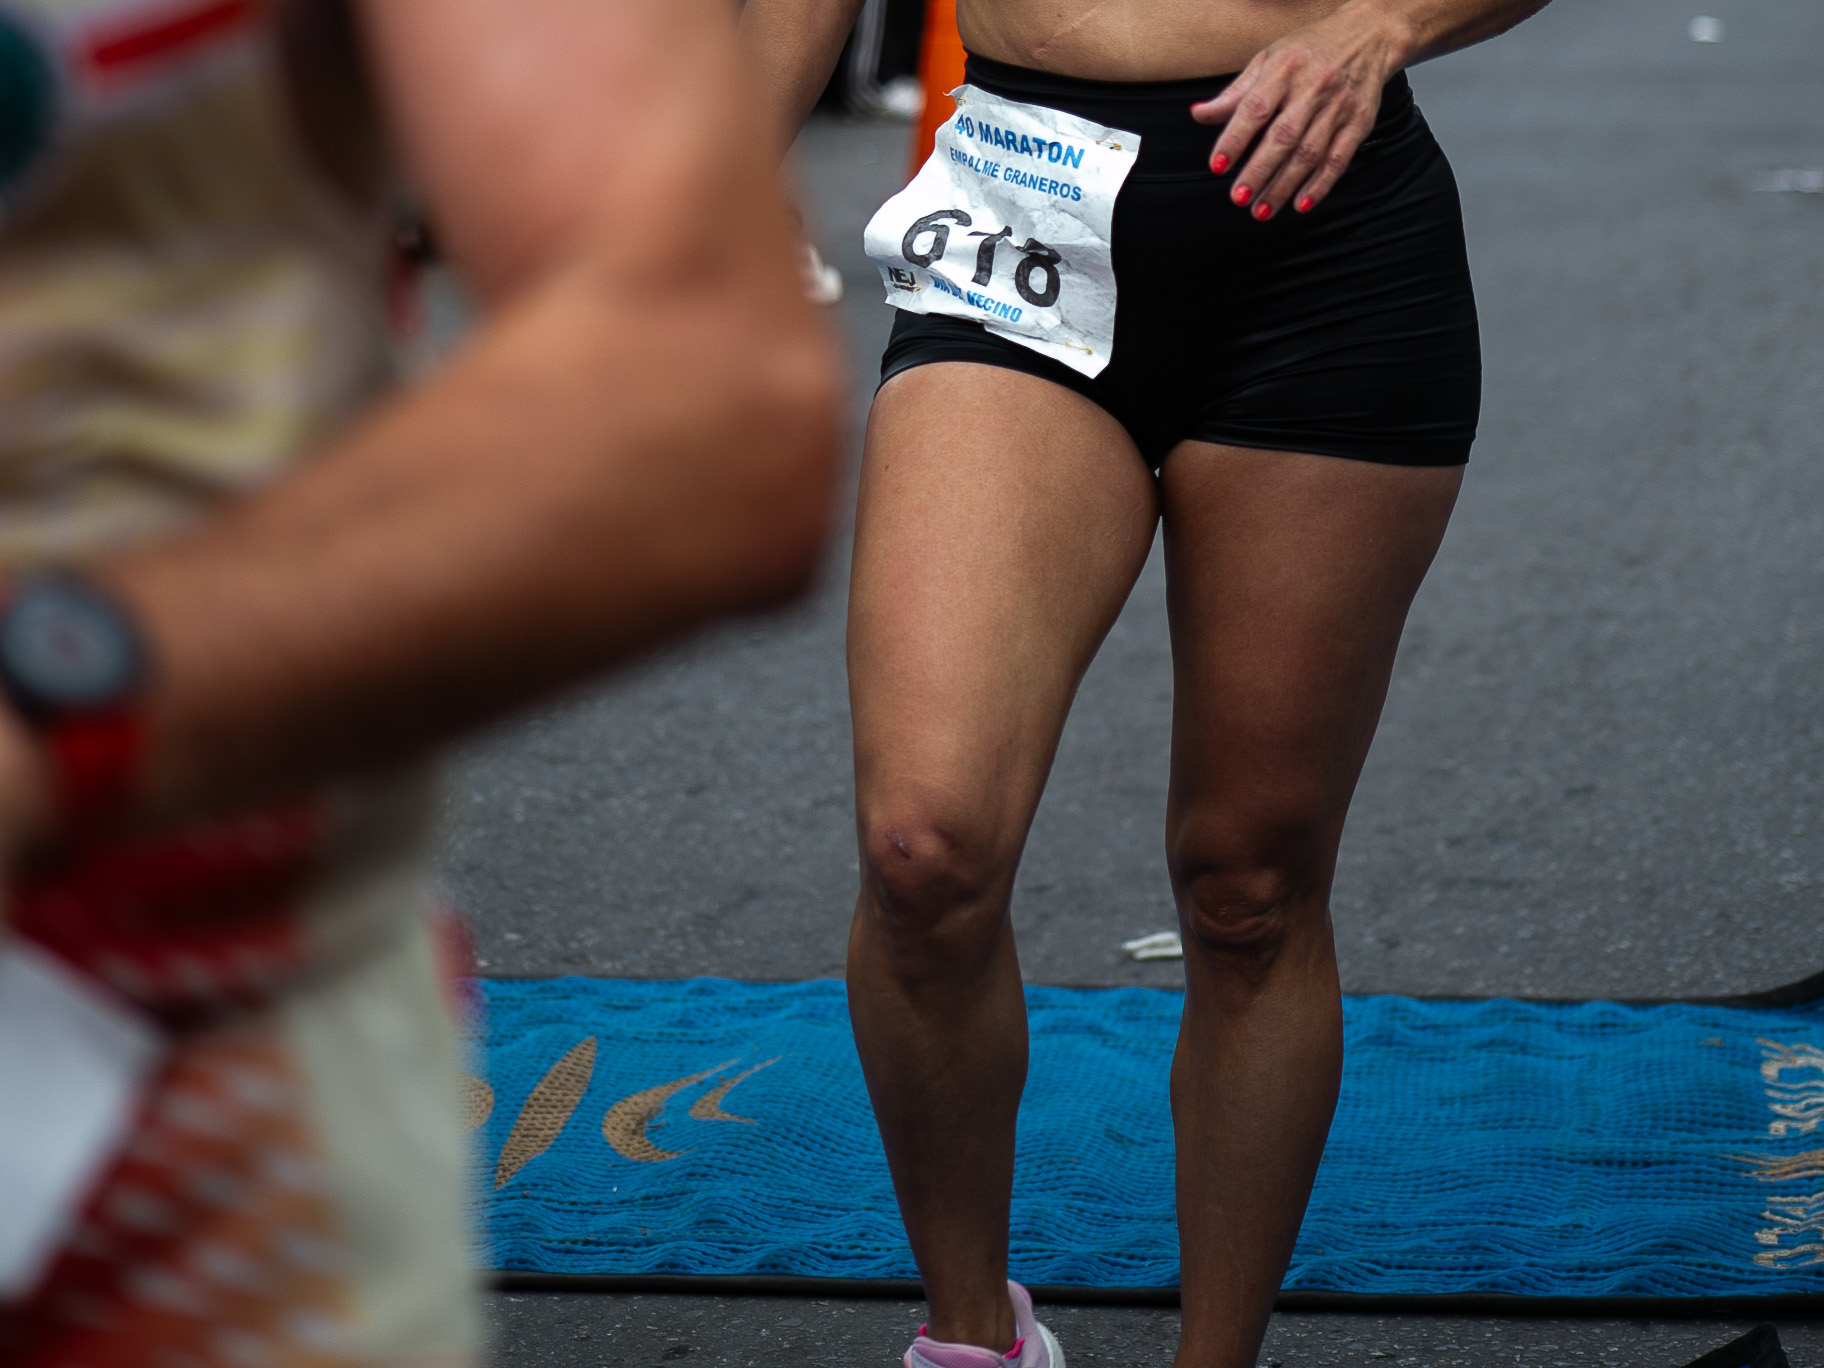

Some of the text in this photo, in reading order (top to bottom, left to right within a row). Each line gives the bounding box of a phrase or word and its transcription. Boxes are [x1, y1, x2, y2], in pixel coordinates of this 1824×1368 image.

[979, 121, 1085, 170] MARATON
[950, 146, 1082, 202] EMPALME GRANEROS
[902, 209, 1062, 308] 618
[966, 290, 1023, 322] VECINO
